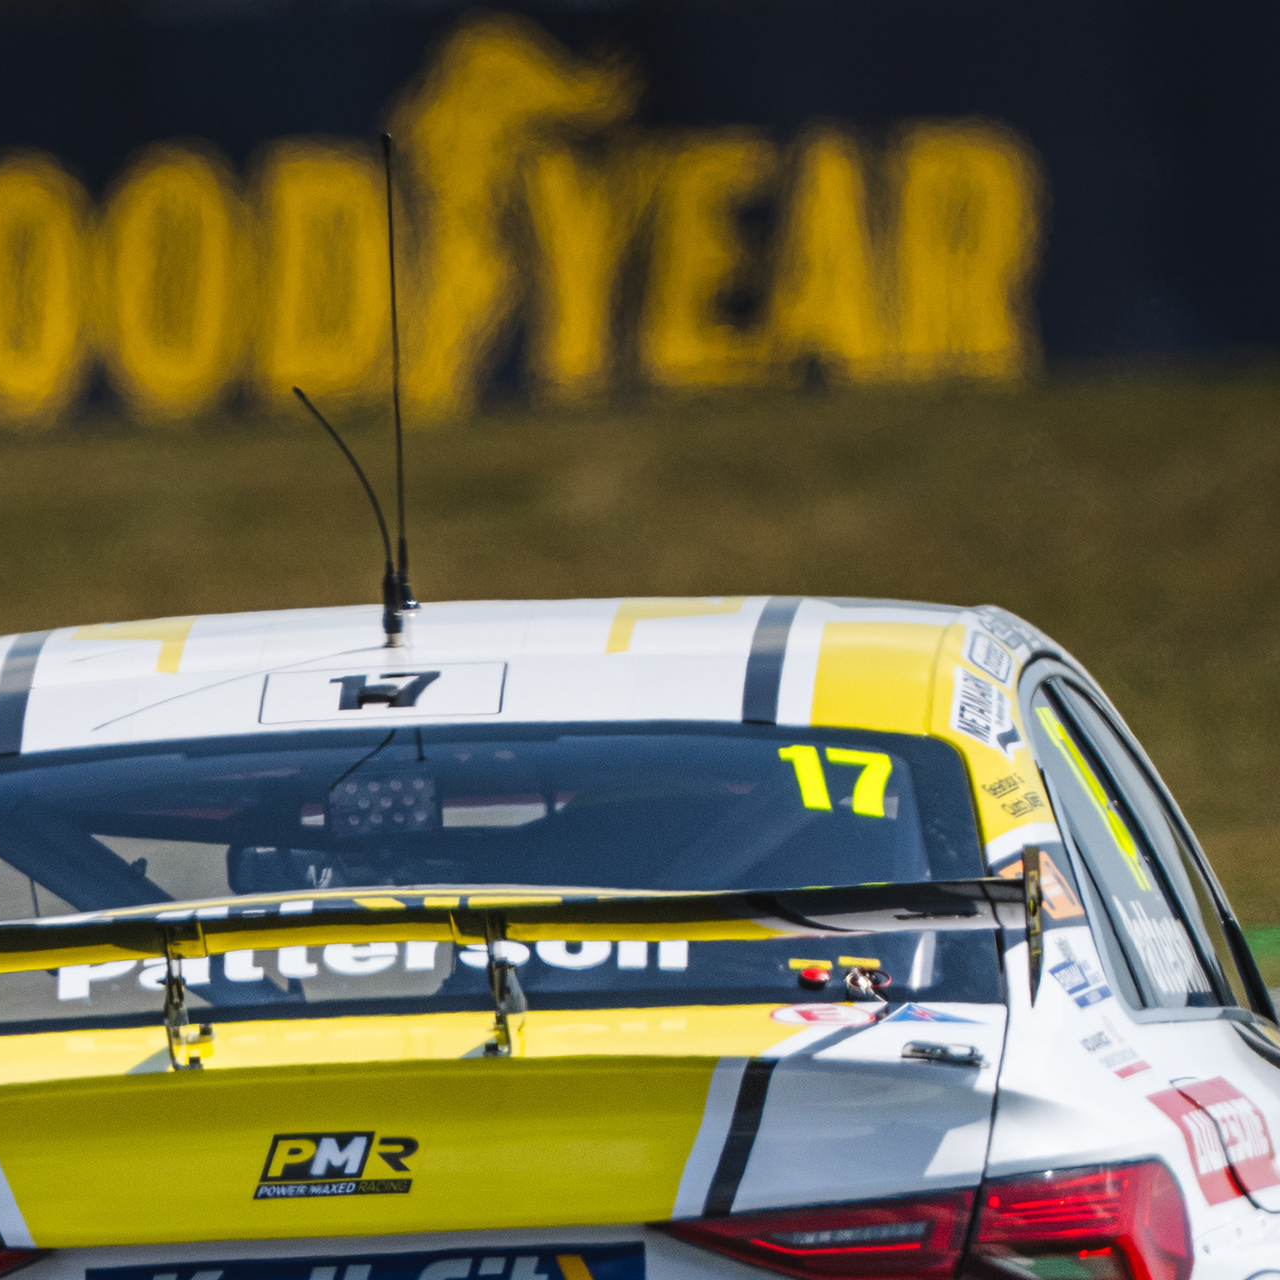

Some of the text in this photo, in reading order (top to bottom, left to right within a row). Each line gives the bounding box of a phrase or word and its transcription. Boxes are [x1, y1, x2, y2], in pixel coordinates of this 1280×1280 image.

[329, 671, 441, 710] 17
[778, 745, 893, 818] 17
[267, 1136, 419, 1177] PMR
[257, 1180, 409, 1198] POWER MAXED RACING
